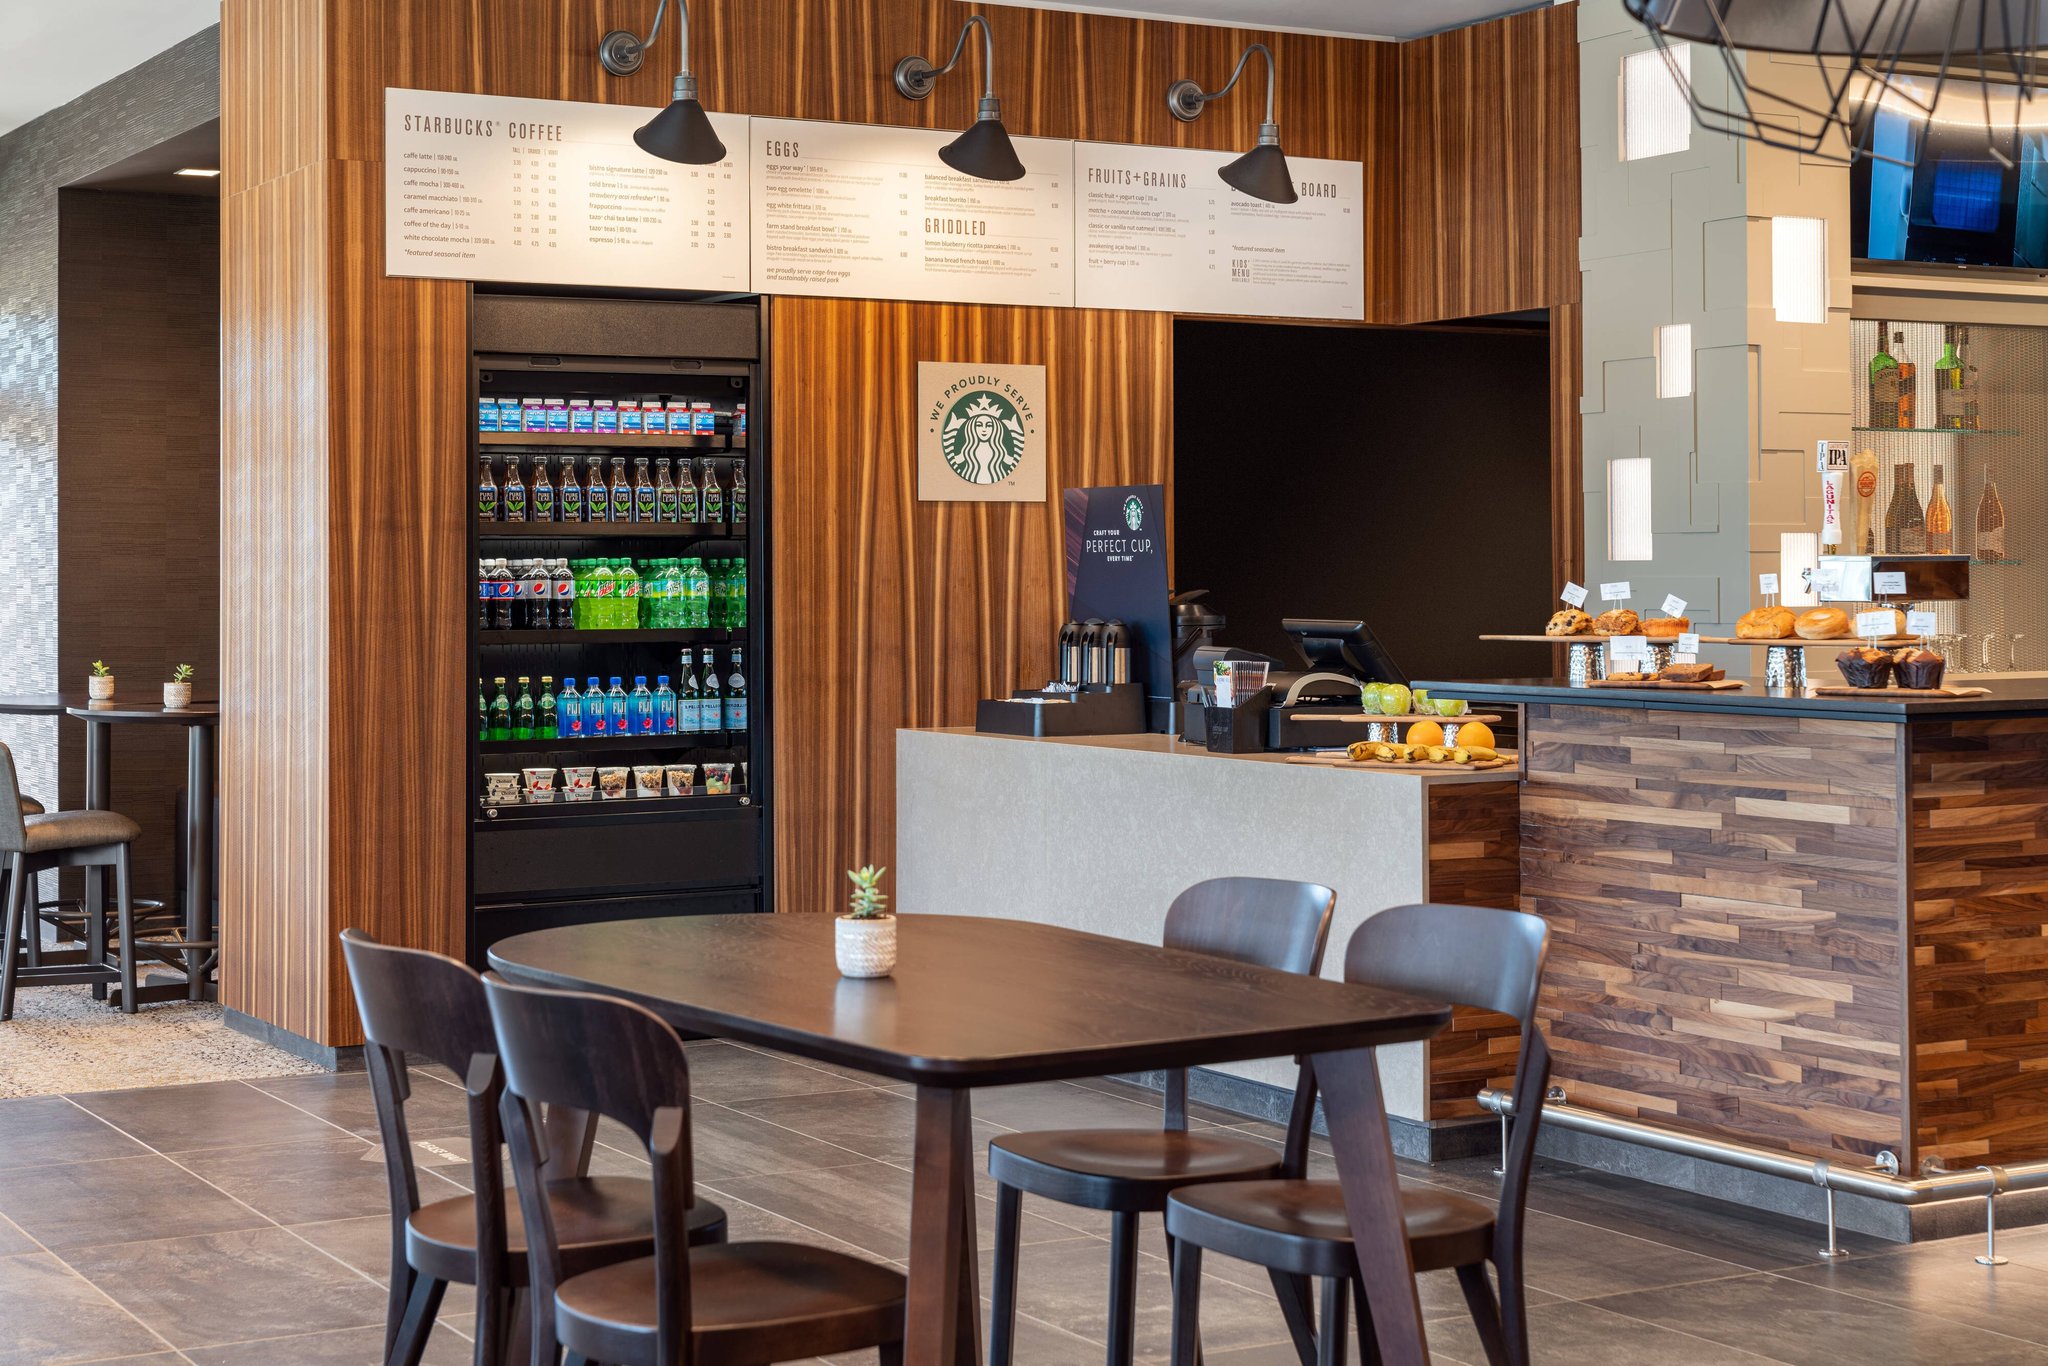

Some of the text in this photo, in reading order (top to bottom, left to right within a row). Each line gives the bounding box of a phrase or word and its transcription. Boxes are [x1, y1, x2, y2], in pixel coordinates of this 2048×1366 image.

[509, 122, 562, 142] COFFEE
[766, 141, 799, 158] EGGS
[404, 166, 437, 174] cappuccino
[606, 165, 631, 173] signature
[1088, 168, 1186, 188] FRUITS+GRAINS
[1302, 182, 1336, 198] BOARD
[589, 192, 618, 200] strawberry
[925, 218, 986, 236] GRIDDLED
[1232, 259, 1250, 268] KIDS'
[778, 275, 809, 283] sustainably
[1232, 269, 1250, 278] MENU
[930, 375, 1034, 421] WE PROUDLY SERVE
[1829, 449, 1847, 465] IPA
[1826, 480, 1835, 524] LAGUNITAS
[1086, 539, 1153, 554] PERFECT CUP,
[567, 703, 580, 715] FIJI
[591, 703, 604, 714] FIJI
[613, 702, 626, 713] FIJI
[639, 702, 652, 713] FIJI
[662, 701, 674, 712] FIJI
